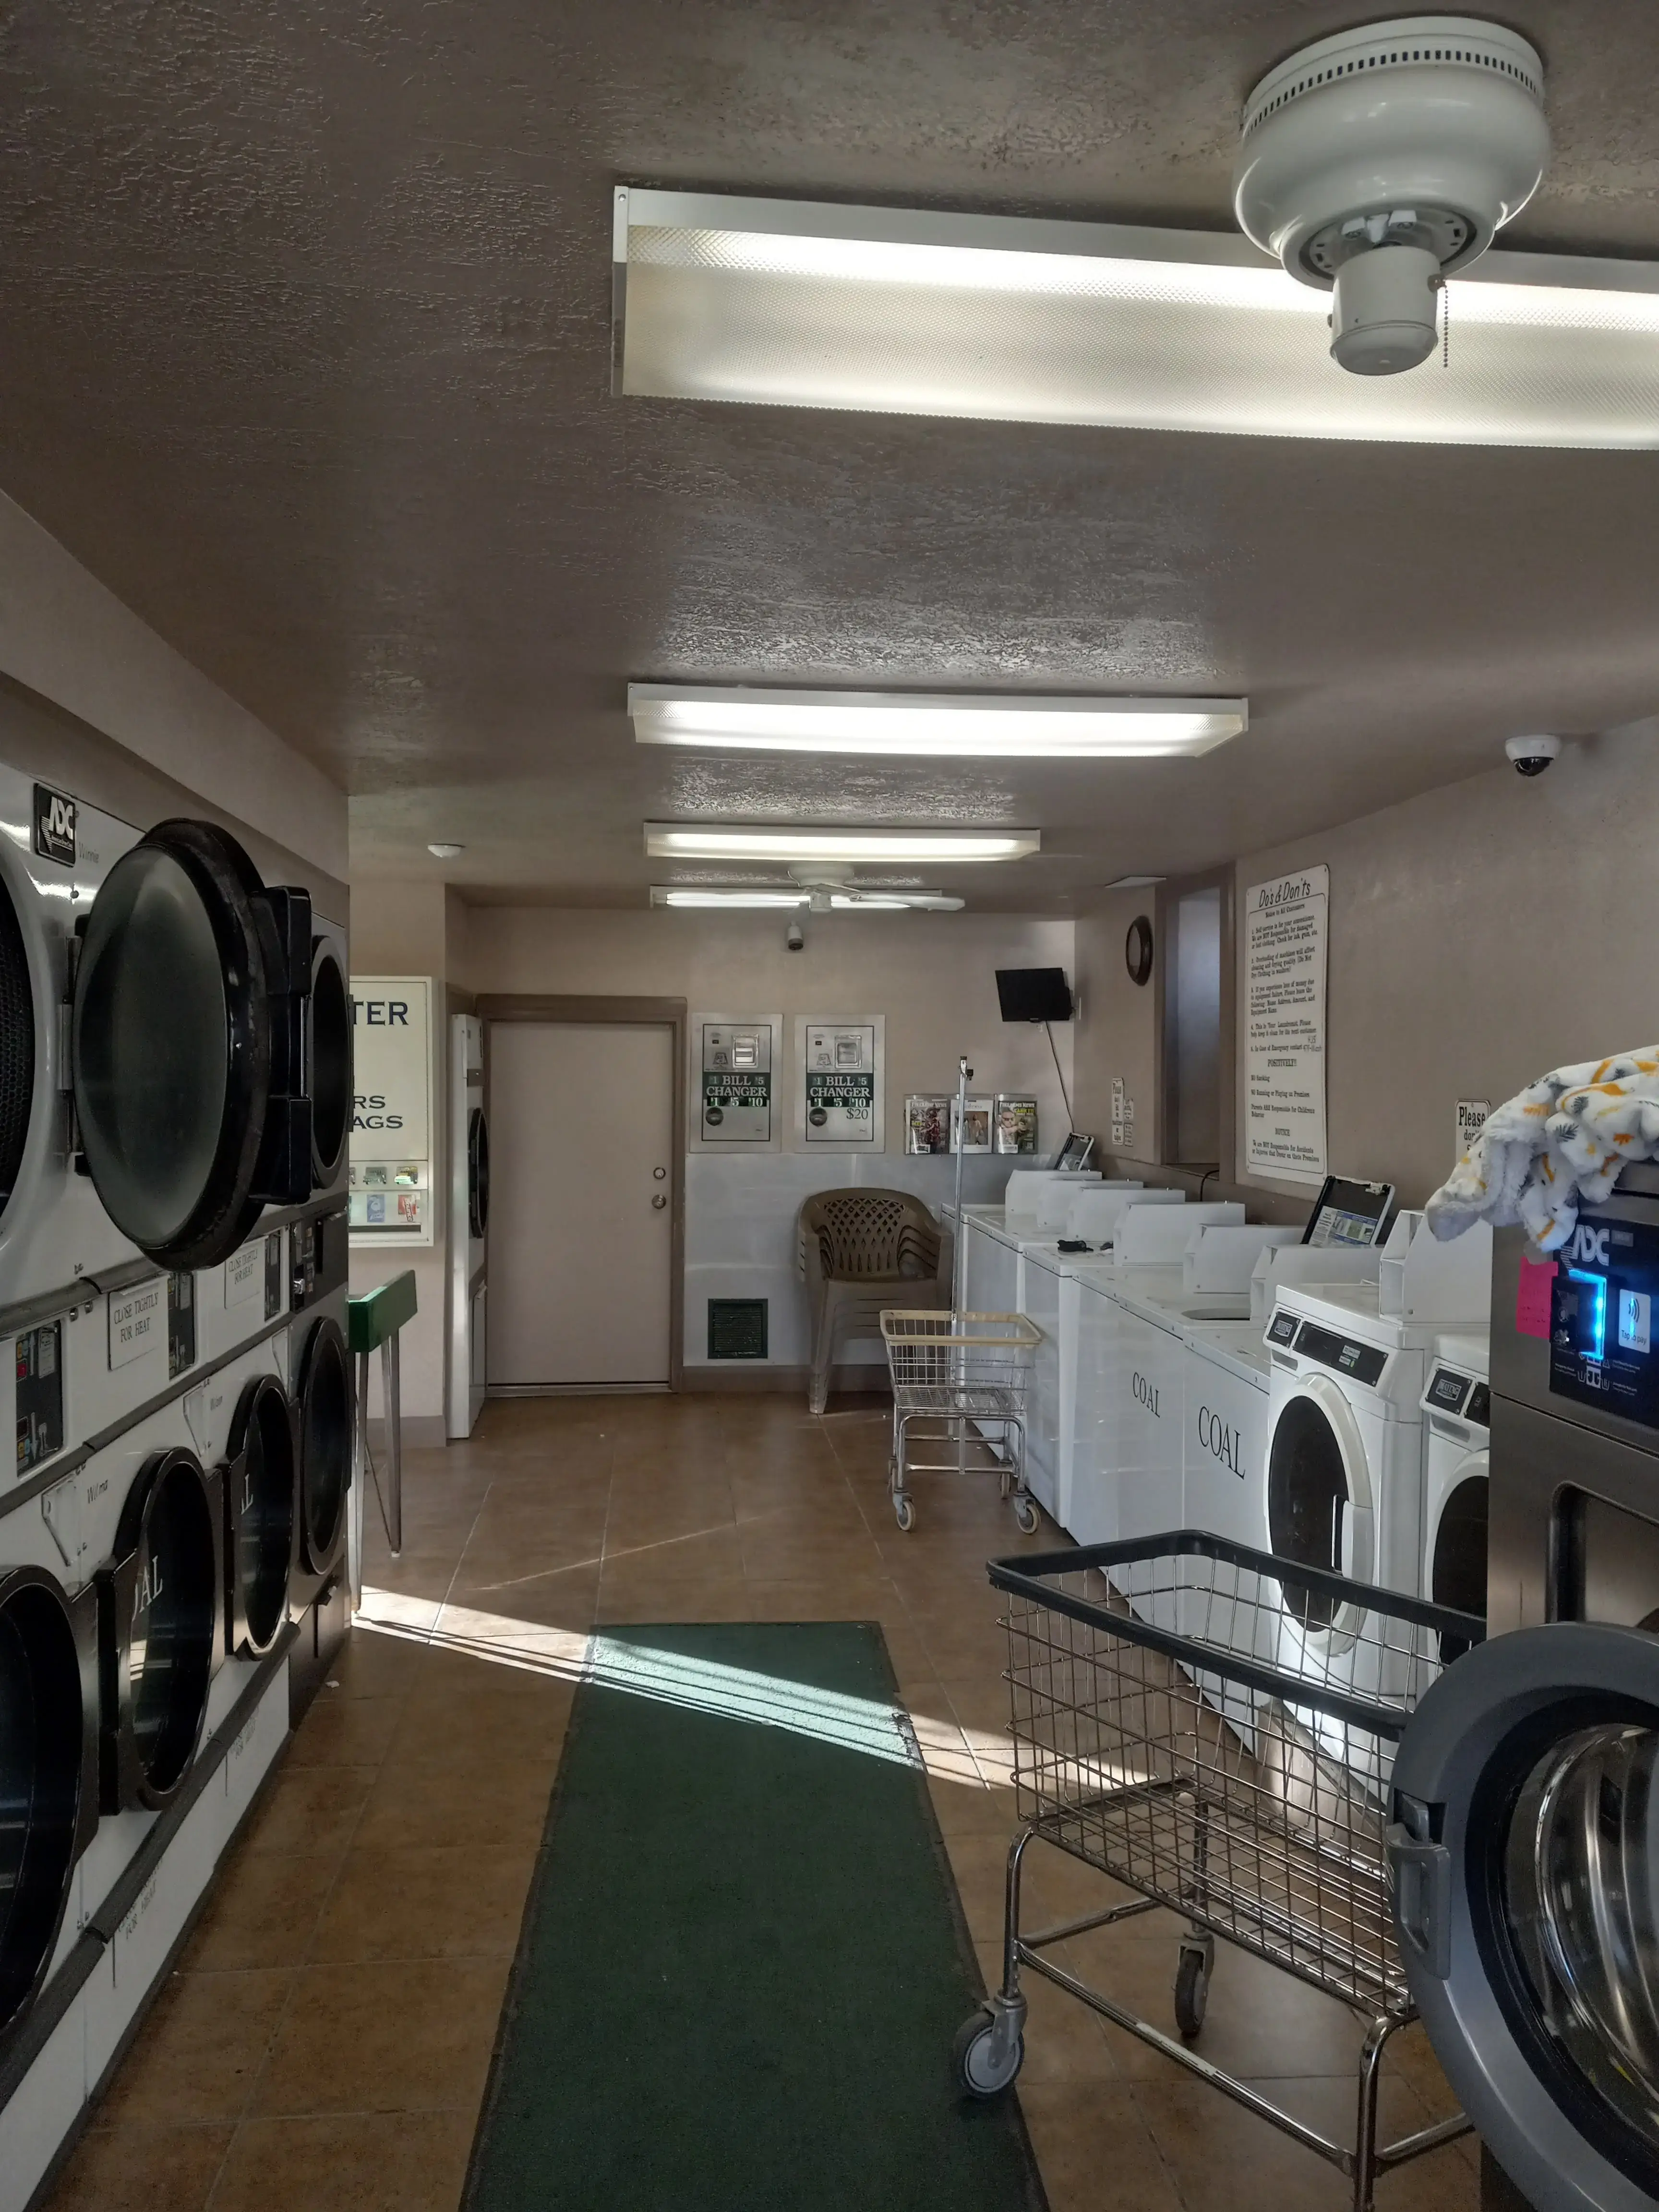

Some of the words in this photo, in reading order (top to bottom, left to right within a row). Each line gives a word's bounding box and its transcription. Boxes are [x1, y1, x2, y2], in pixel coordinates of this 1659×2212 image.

[49, 796, 73, 840] ADC
[1259, 888, 1274, 908] Do's
[722, 1075, 751, 1085] BILL
[826, 1076, 854, 1086] BILL
[706, 1086, 768, 1097] CHANGER
[810, 1087, 871, 1097] CHANGER
[846, 1108, 868, 1120] $20
[1459, 1106, 1485, 1127] Please
[1571, 1225, 1610, 1266] ADC
[114, 1304, 132, 1324] CLOSE
[134, 1292, 158, 1314] TIGHTLY
[120, 1326, 132, 1342] FOR
[135, 1317, 150, 1336] HEAT
[1622, 1330, 1630, 1341] Tap
[1637, 1336, 1647, 1346] pay
[1133, 1372, 1160, 1418] COAL
[1199, 1406, 1246, 1480] COAL
